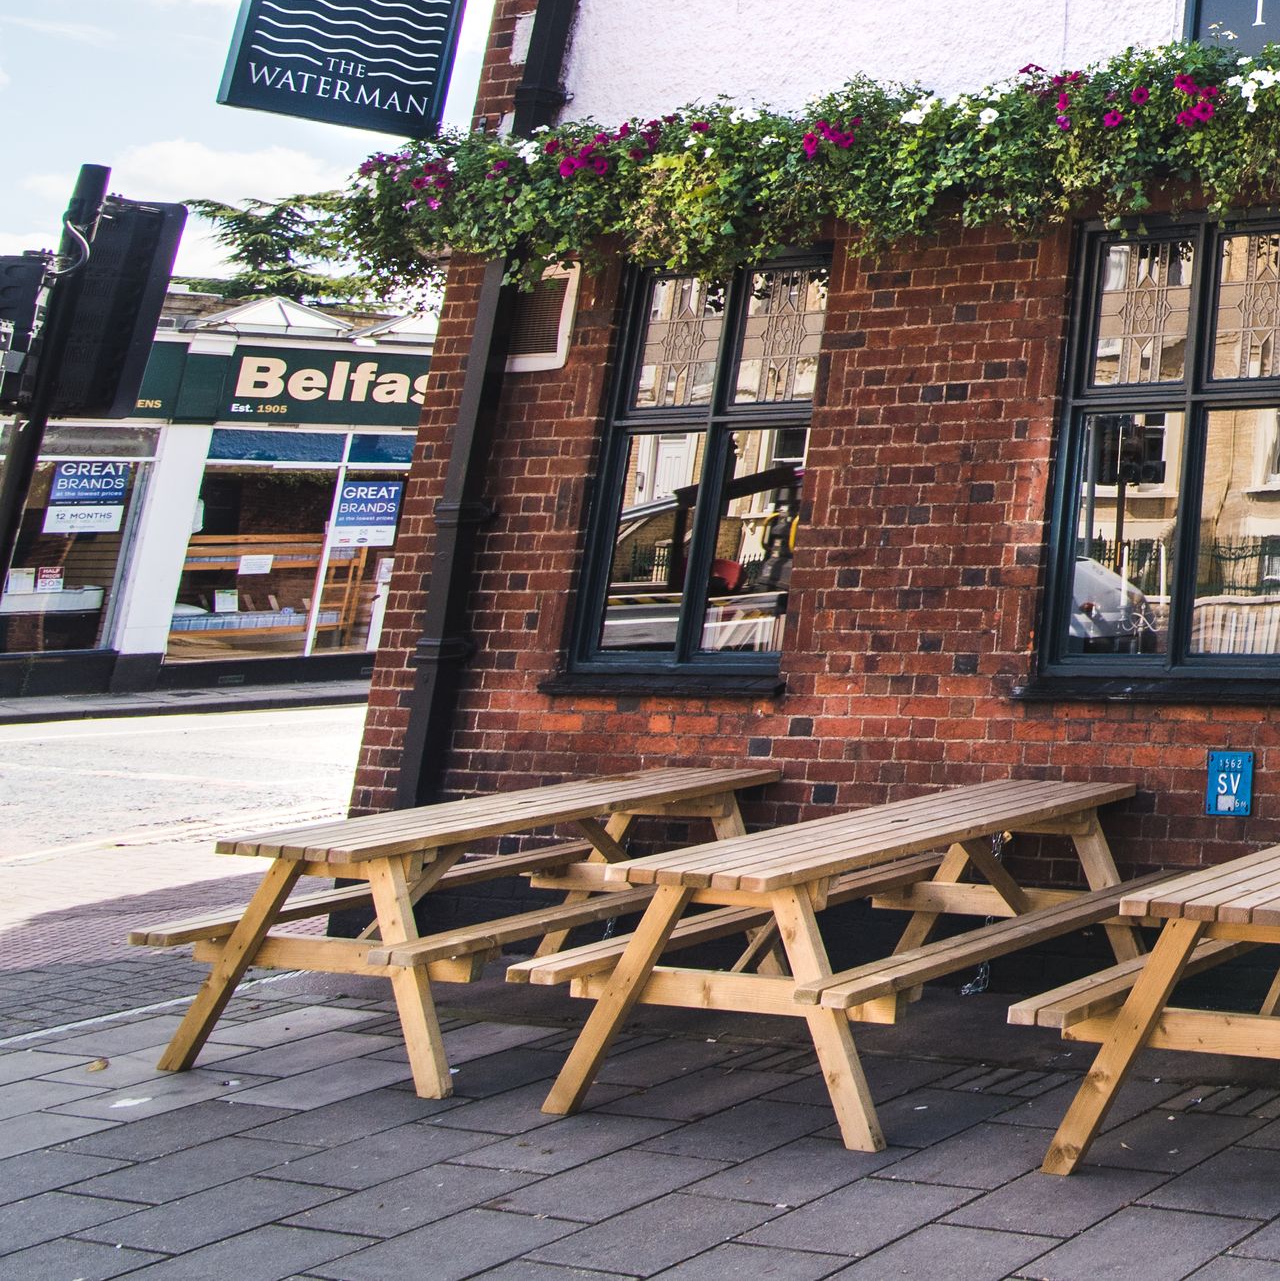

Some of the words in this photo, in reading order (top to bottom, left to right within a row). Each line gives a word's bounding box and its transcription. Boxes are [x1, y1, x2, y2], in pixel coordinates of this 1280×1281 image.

[326, 57, 367, 79] THE
[248, 61, 430, 118] WATERMAN
[231, 403, 253, 413] Est.
[256, 404, 288, 414] 1905
[61, 462, 127, 476] GREAT
[57, 478, 124, 490] BRANDS
[343, 486, 399, 499] GREAT
[339, 502, 396, 513] BRANDS
[69, 512, 113, 520] MONTHS
[1217, 773, 1241, 795] SV
